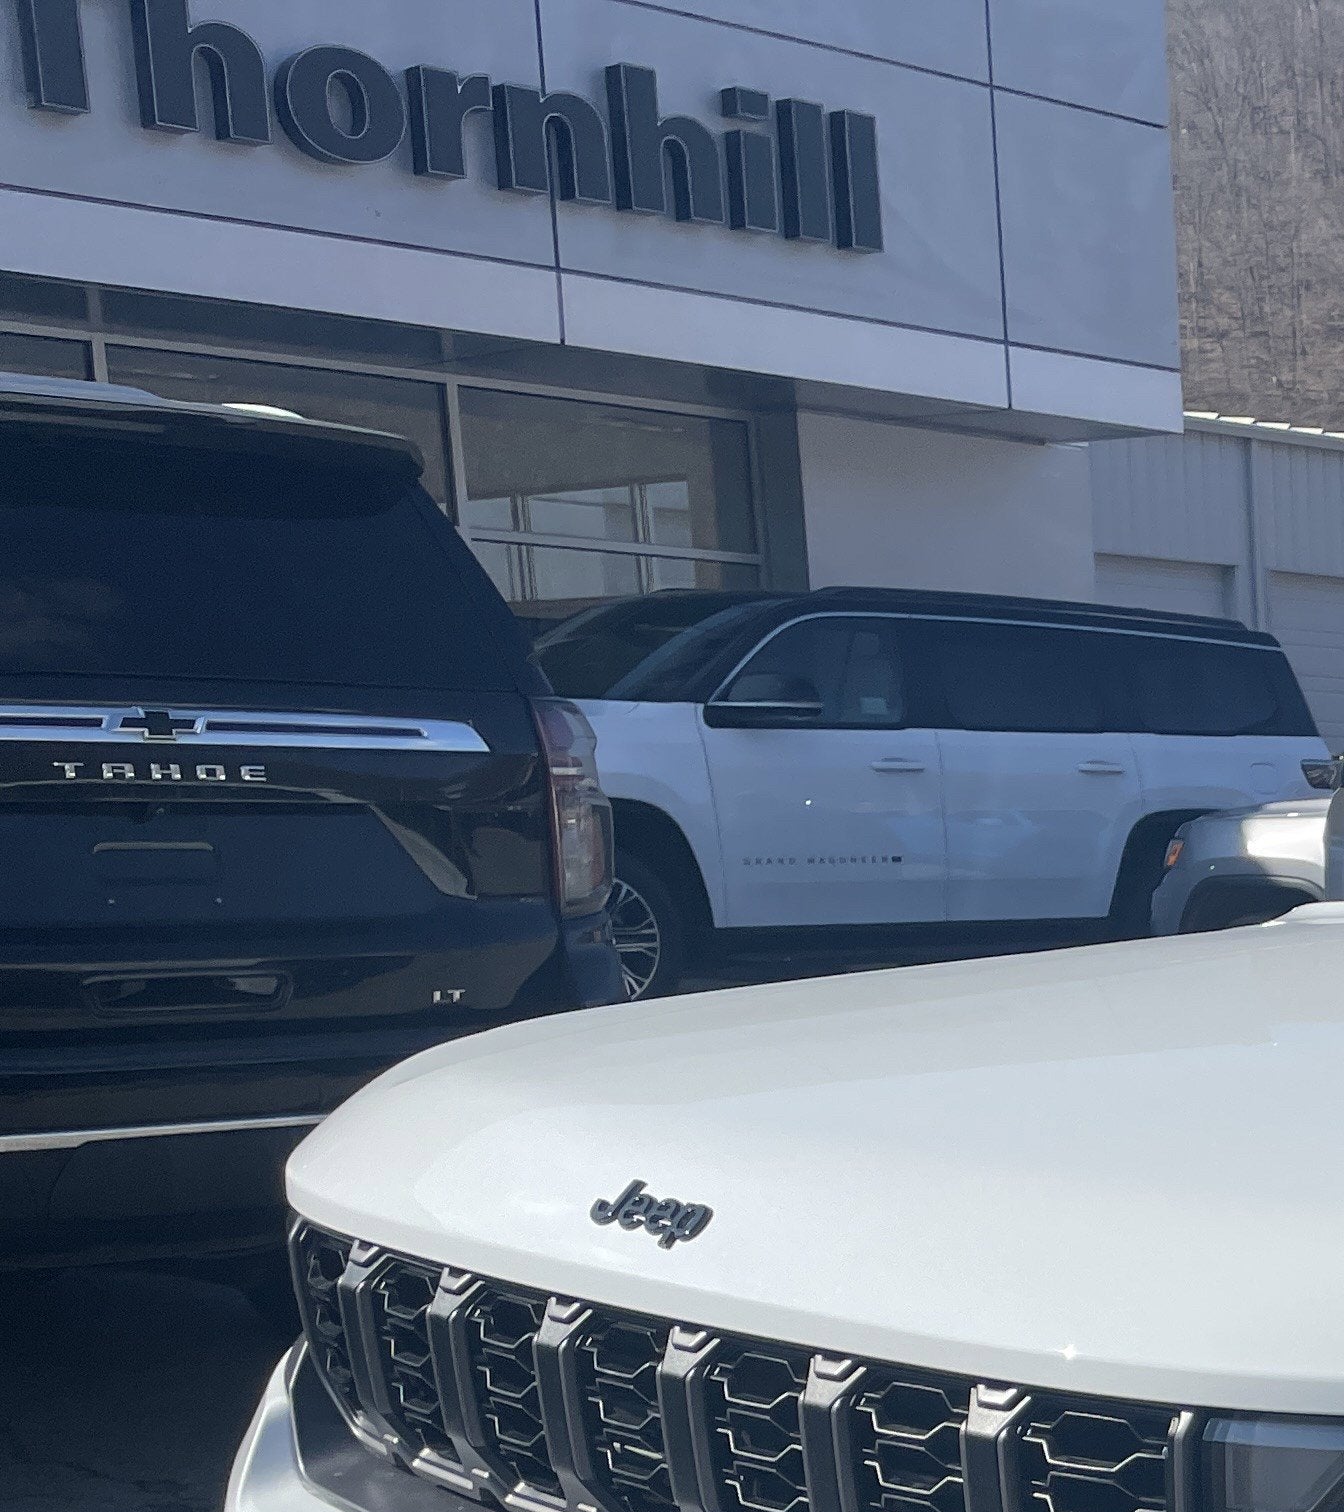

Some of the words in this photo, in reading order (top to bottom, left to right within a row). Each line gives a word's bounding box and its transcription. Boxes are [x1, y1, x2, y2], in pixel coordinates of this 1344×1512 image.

[53, 762, 267, 782] TAHOE
[432, 988, 466, 1004] LT
[590, 1179, 714, 1250] Jeep
